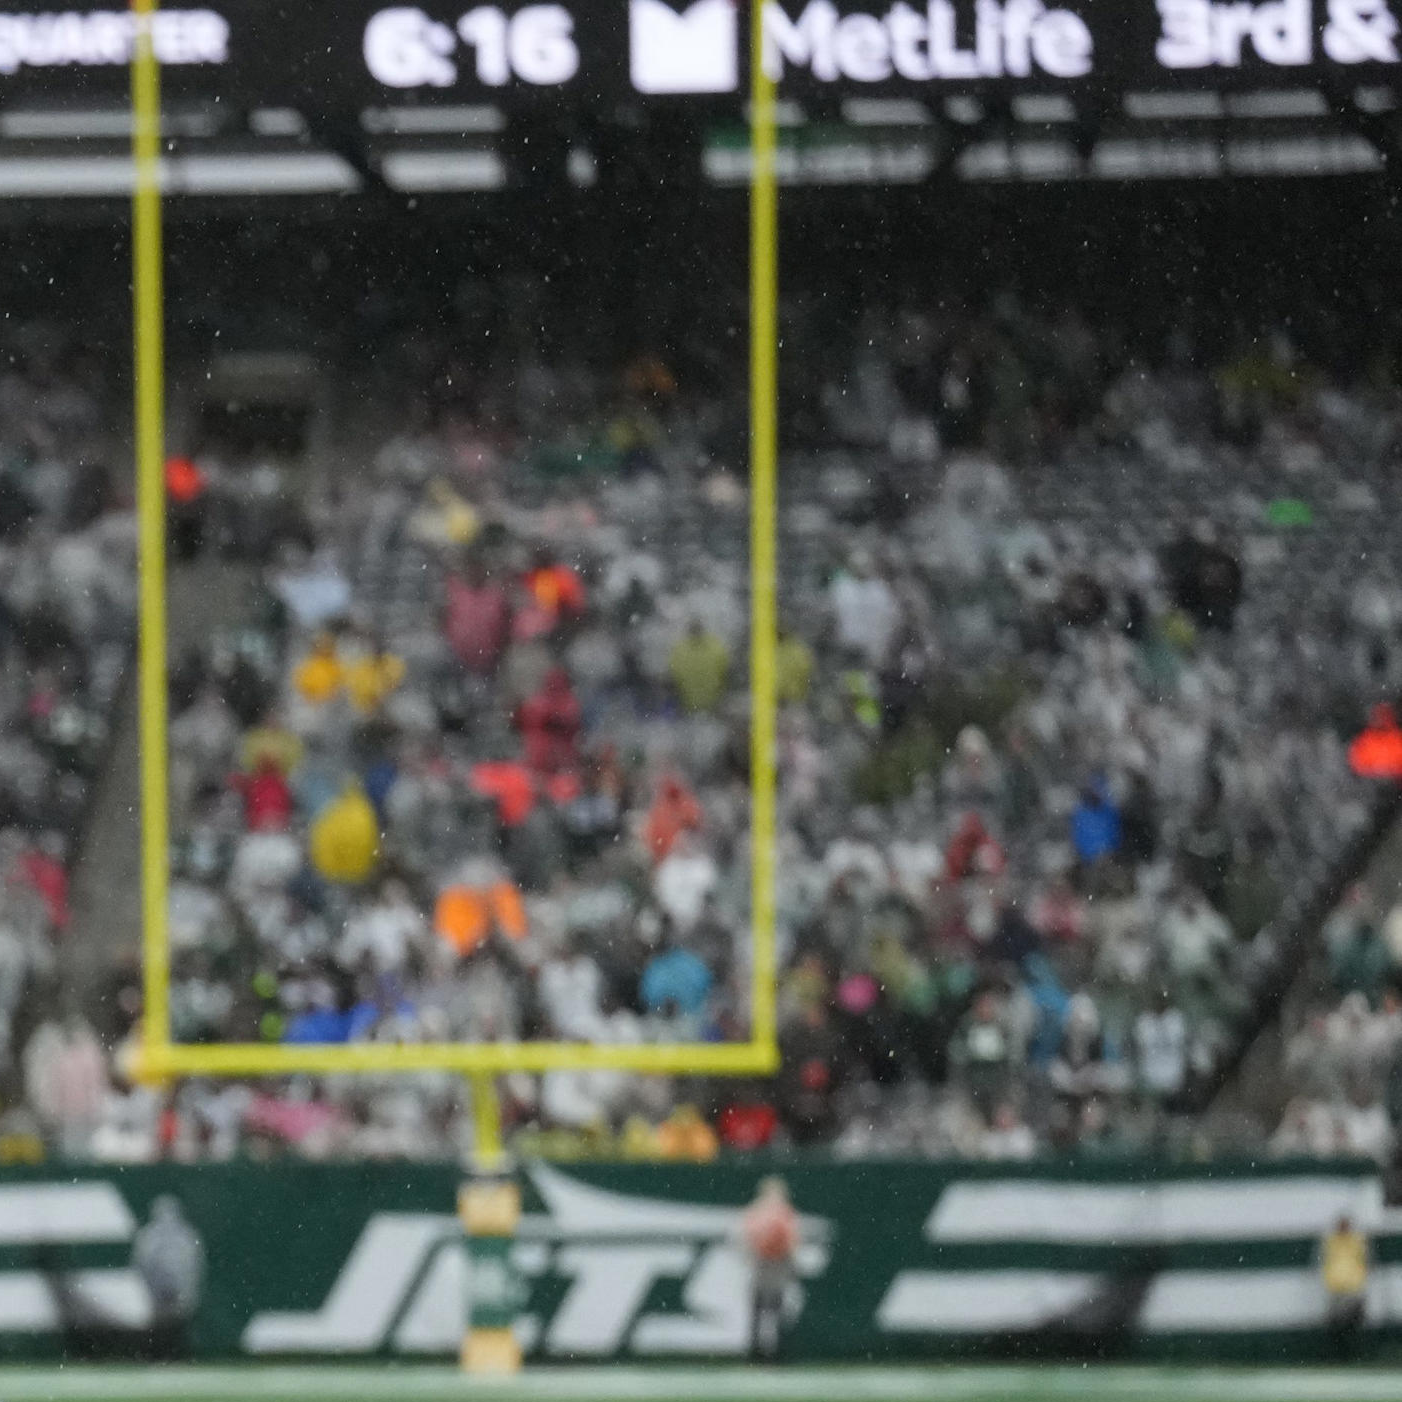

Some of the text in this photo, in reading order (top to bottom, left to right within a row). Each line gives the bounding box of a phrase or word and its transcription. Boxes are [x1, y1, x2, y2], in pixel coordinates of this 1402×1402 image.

[363, 3, 581, 87] 6:16
[761, 0, 1094, 82] MetLife
[1154, 0, 1313, 68] 3rd
